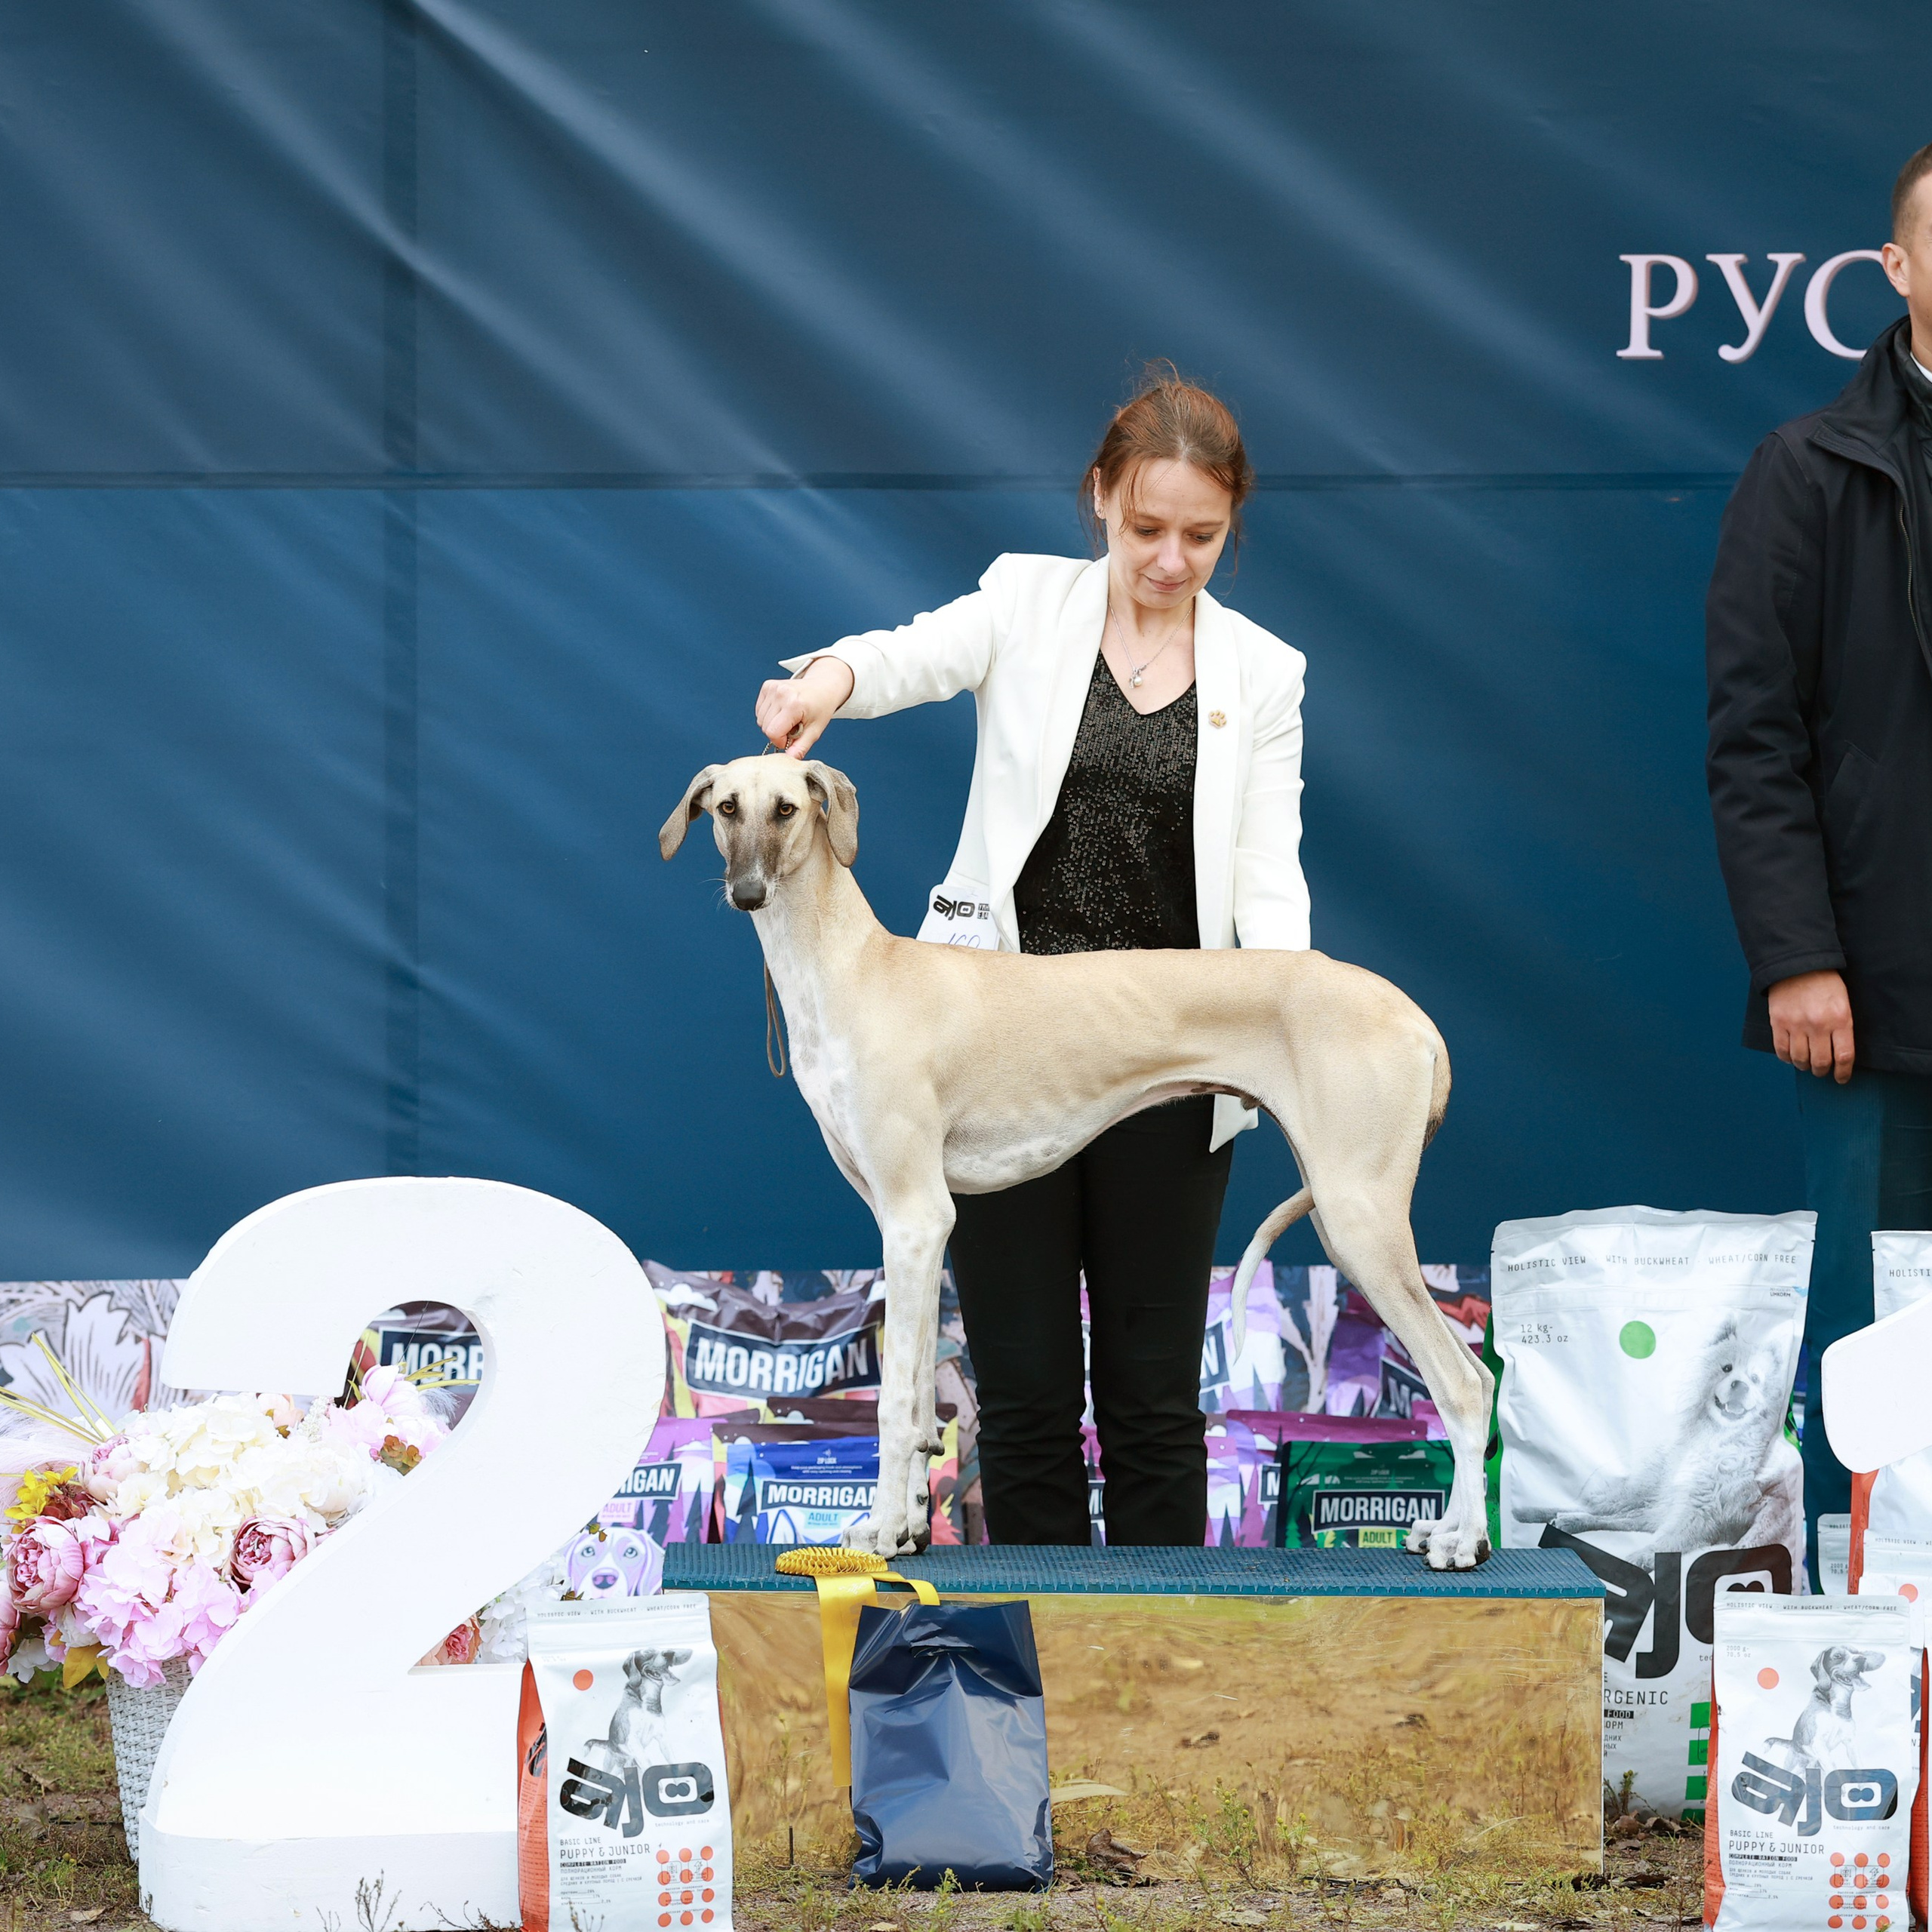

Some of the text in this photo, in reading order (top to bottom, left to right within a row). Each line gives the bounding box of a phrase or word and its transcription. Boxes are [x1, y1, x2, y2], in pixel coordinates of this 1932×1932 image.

[1507, 1254, 1797, 1272] HOLISTIC VIEW WITH BUCKWHEAT WHEAT/CORN FREE
[1521, 1324, 1533, 1334] 12
[1521, 1334, 1552, 1345] 423.3
[694, 1336, 869, 1394] MORRIGAN
[1321, 1497, 1437, 1523] MORRIGAN
[808, 1512, 838, 1522] ADULT
[1363, 1531, 1393, 1543] ADULT
[1606, 1710, 1632, 1718] FOOD
[1730, 1829, 1774, 1839] BASIC LINE
[560, 1838, 580, 1846] BASIC
[1729, 1840, 1824, 1855] PUPPY & JUNIOR
[560, 1843, 651, 1860] PUPPY & JUNIOR
